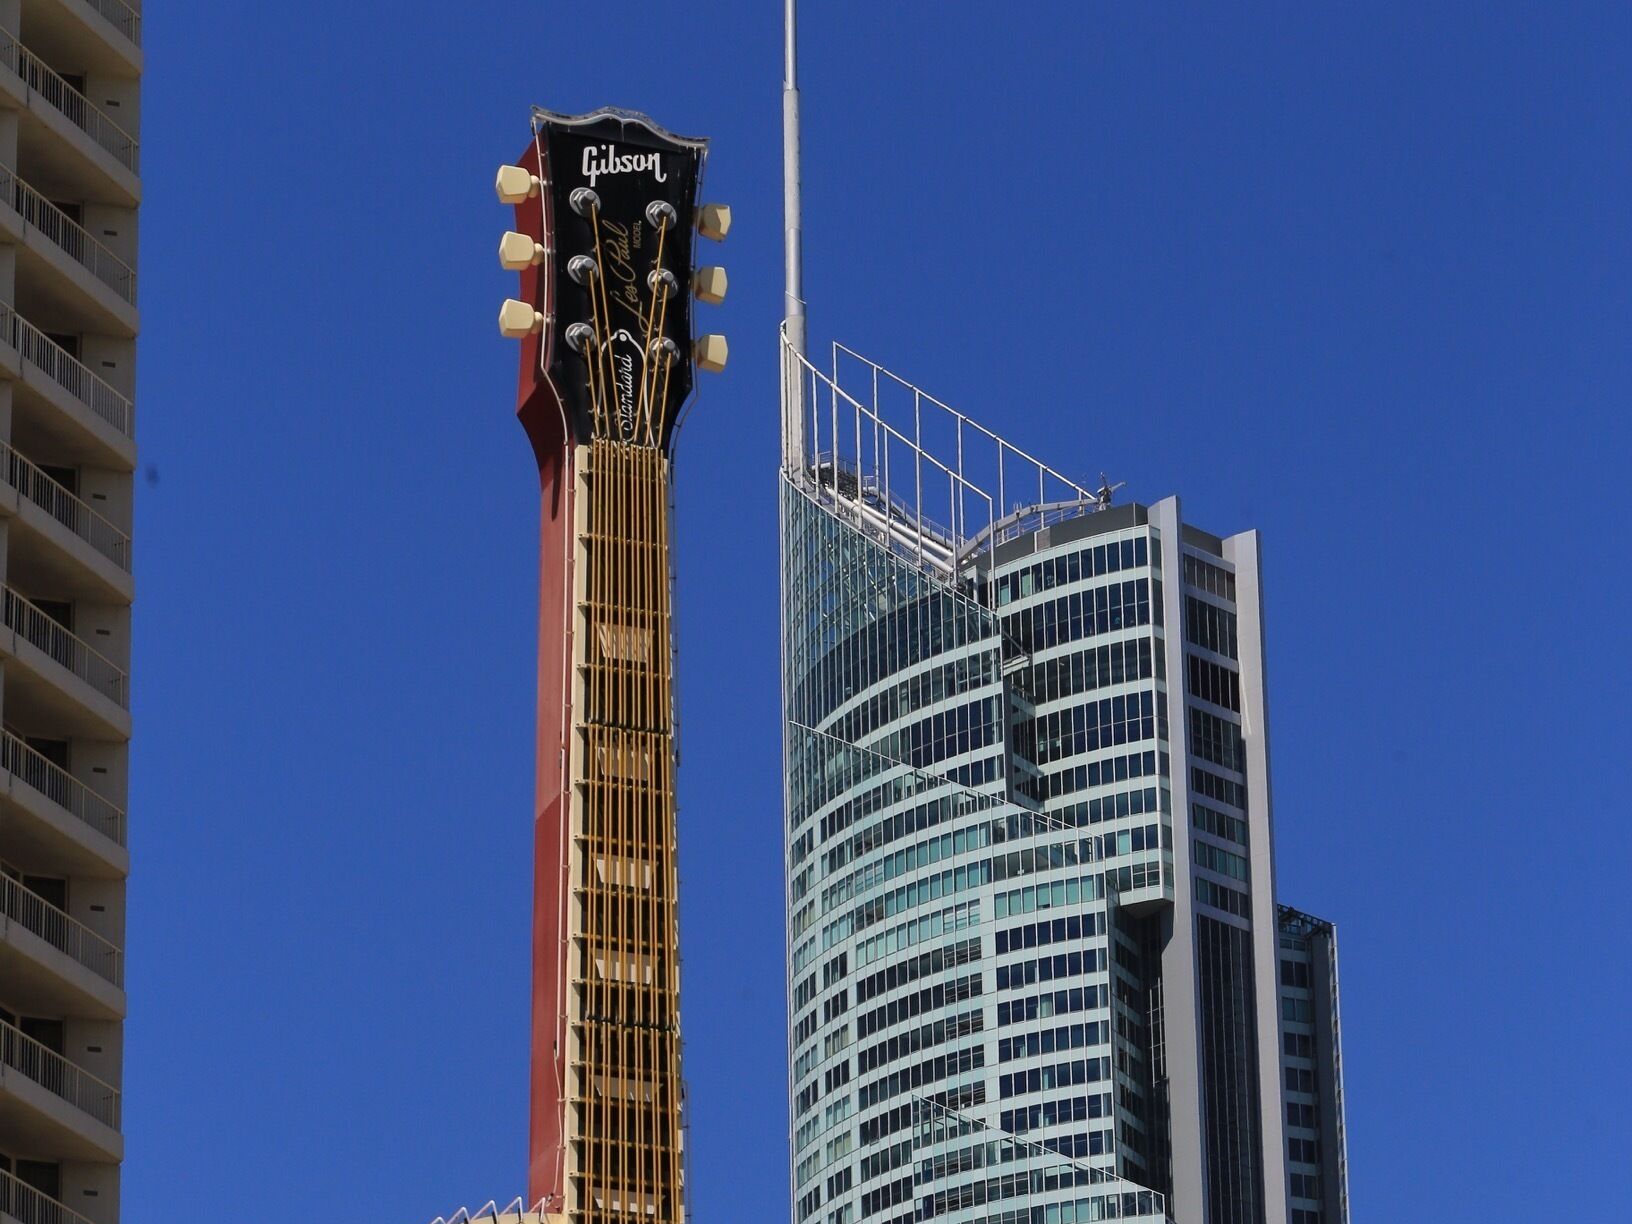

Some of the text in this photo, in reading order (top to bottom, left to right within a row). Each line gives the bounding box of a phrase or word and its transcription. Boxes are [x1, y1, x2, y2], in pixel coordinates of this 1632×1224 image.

[582, 144, 667, 187] Gibson
[602, 219, 636, 281] Paul
[633, 222, 641, 249] MODEL
[614, 354, 633, 431] Standard
